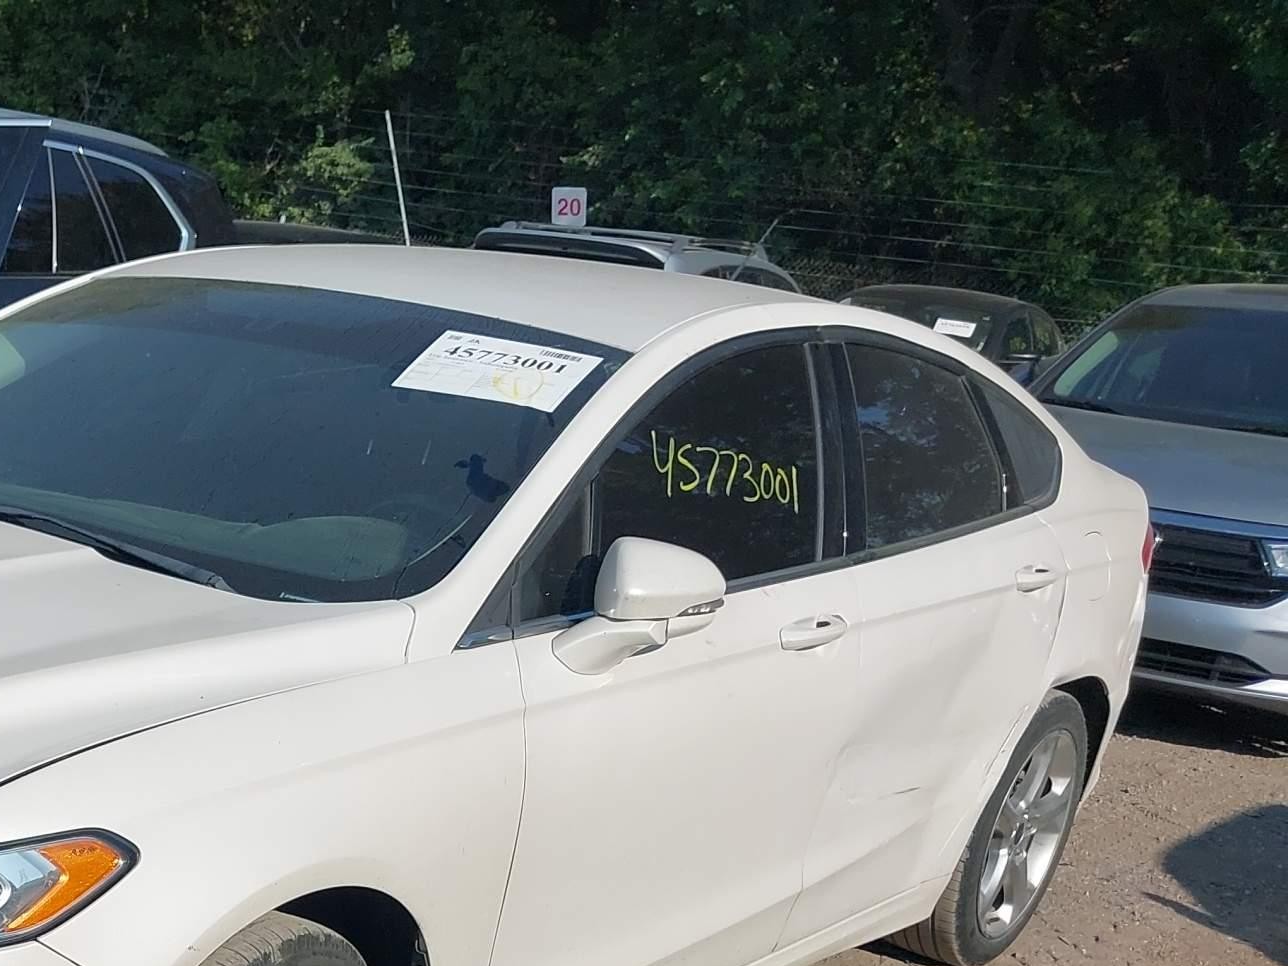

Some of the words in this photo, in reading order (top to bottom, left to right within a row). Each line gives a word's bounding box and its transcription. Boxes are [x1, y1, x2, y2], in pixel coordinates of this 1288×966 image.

[557, 198, 581, 216] 20
[443, 345, 568, 374] 45773001
[650, 429, 800, 515] 45773001
